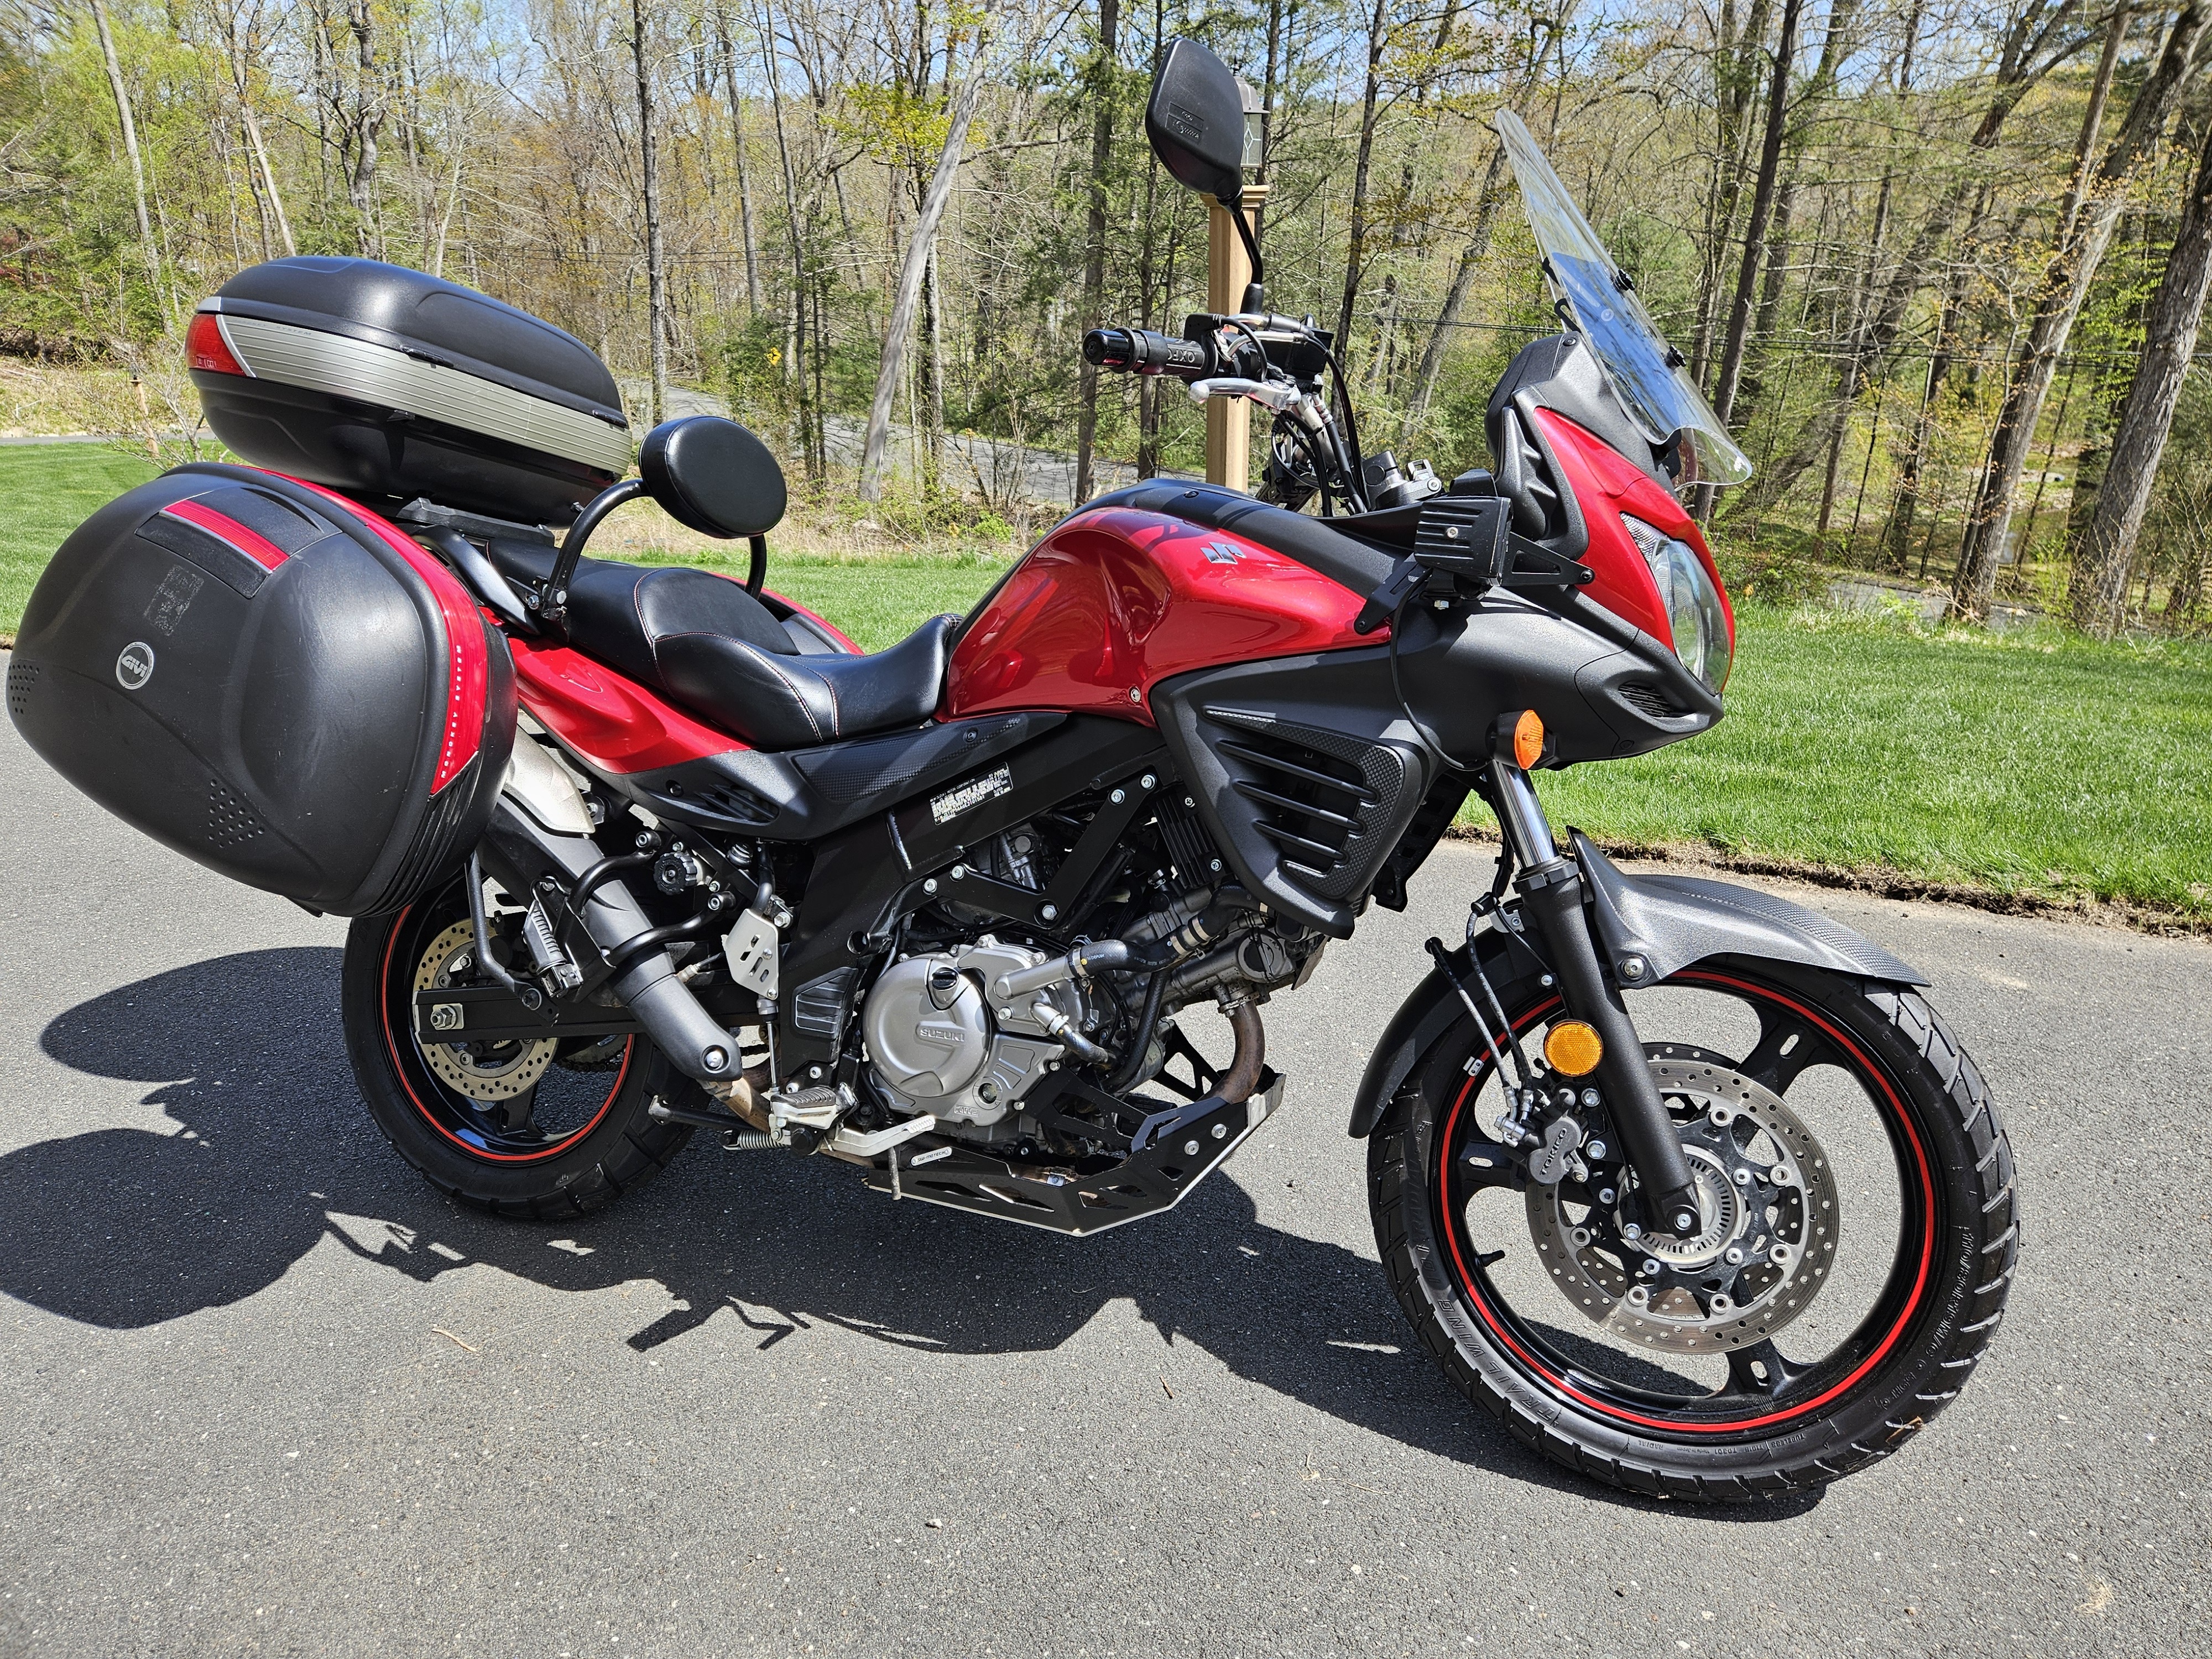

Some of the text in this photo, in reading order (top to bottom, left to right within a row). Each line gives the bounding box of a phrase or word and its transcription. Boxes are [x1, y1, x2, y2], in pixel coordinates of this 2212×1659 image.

[276, 326, 312, 336] SYSTEM
[1167, 348, 1195, 363] OXFO
[122, 655, 148, 678] GIVI
[441, 711, 458, 779] MONOKEY
[920, 1028, 964, 1042] SUZUKI
[917, 1151, 945, 1162] SW-MOTECH
[1540, 1128, 1567, 1175] TOKICO
[1438, 1299, 1486, 1358] WING
[1487, 1360, 1555, 1421] TRAIL
[1638, 1439, 1663, 1451] RADIAL
